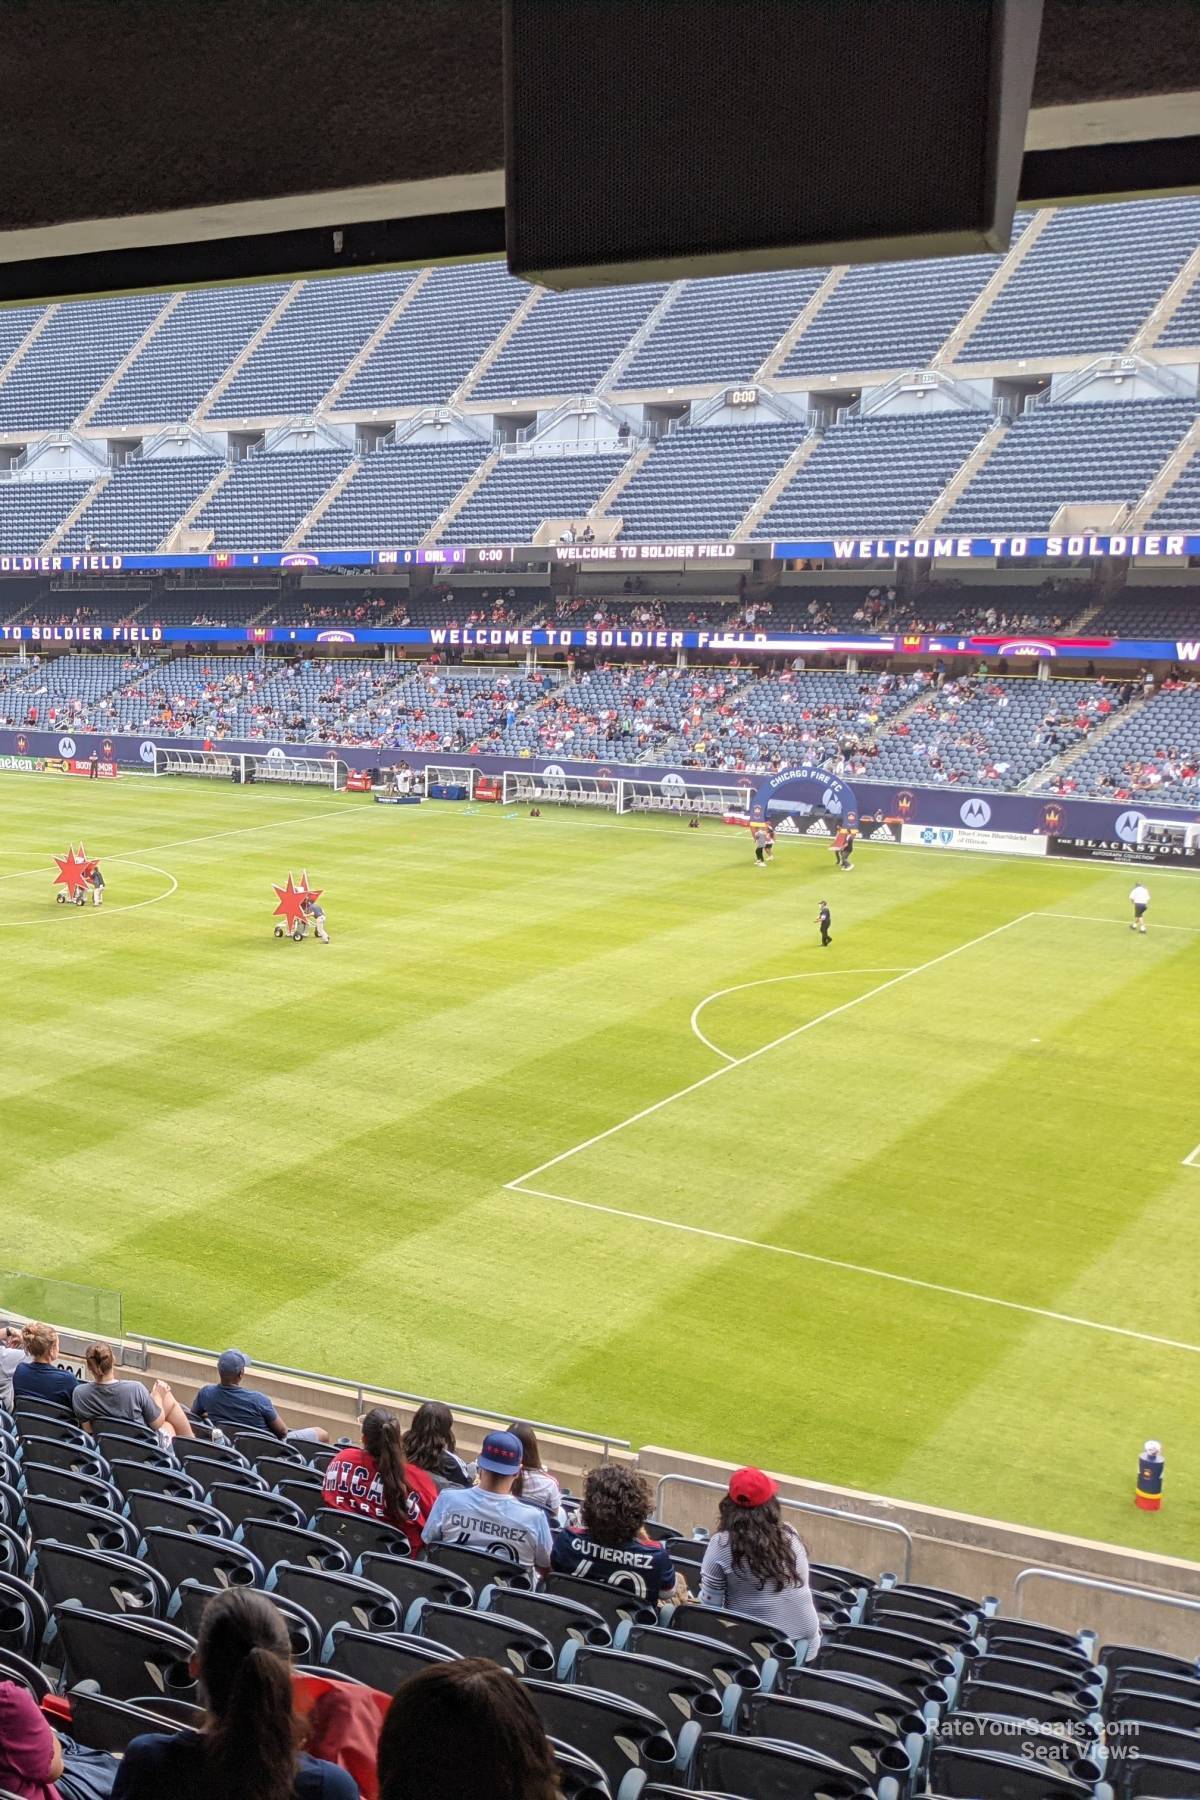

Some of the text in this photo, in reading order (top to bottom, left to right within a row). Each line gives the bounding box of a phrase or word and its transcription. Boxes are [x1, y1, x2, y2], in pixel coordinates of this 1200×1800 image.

[733, 390, 756, 403] 0:00
[556, 545, 735, 559] WELCOME TO SOLDIER FIELD
[833, 537, 1184, 558] WELCOME TO SOLDIER
[378, 551, 411, 563] CHI 0
[424, 550, 460, 562] ORL 0
[479, 549, 503, 561] 0:00
[72, 556, 122, 569] FIELD
[3, 627, 22, 639] TO
[31, 627, 102, 640] SOLDIER
[113, 628, 161, 641] FIELD
[430, 629, 532, 644] WELCOME
[547, 630, 571, 645] TO
[586, 631, 683, 647] SOLDIER
[769, 769, 843, 792] CHICAGO FIRE FC
[774, 825, 800, 833] adidas
[806, 828, 831, 836] adidas
[870, 833, 896, 841] adidas
[1074, 839, 1196, 856] BLACKSTONE
[1123, 853, 1156, 861] COLLECTION
[335, 1496, 385, 1517] FIRE
[450, 1513, 528, 1543] GUTIERREZ
[571, 1538, 654, 1570] GUTIERREZ
